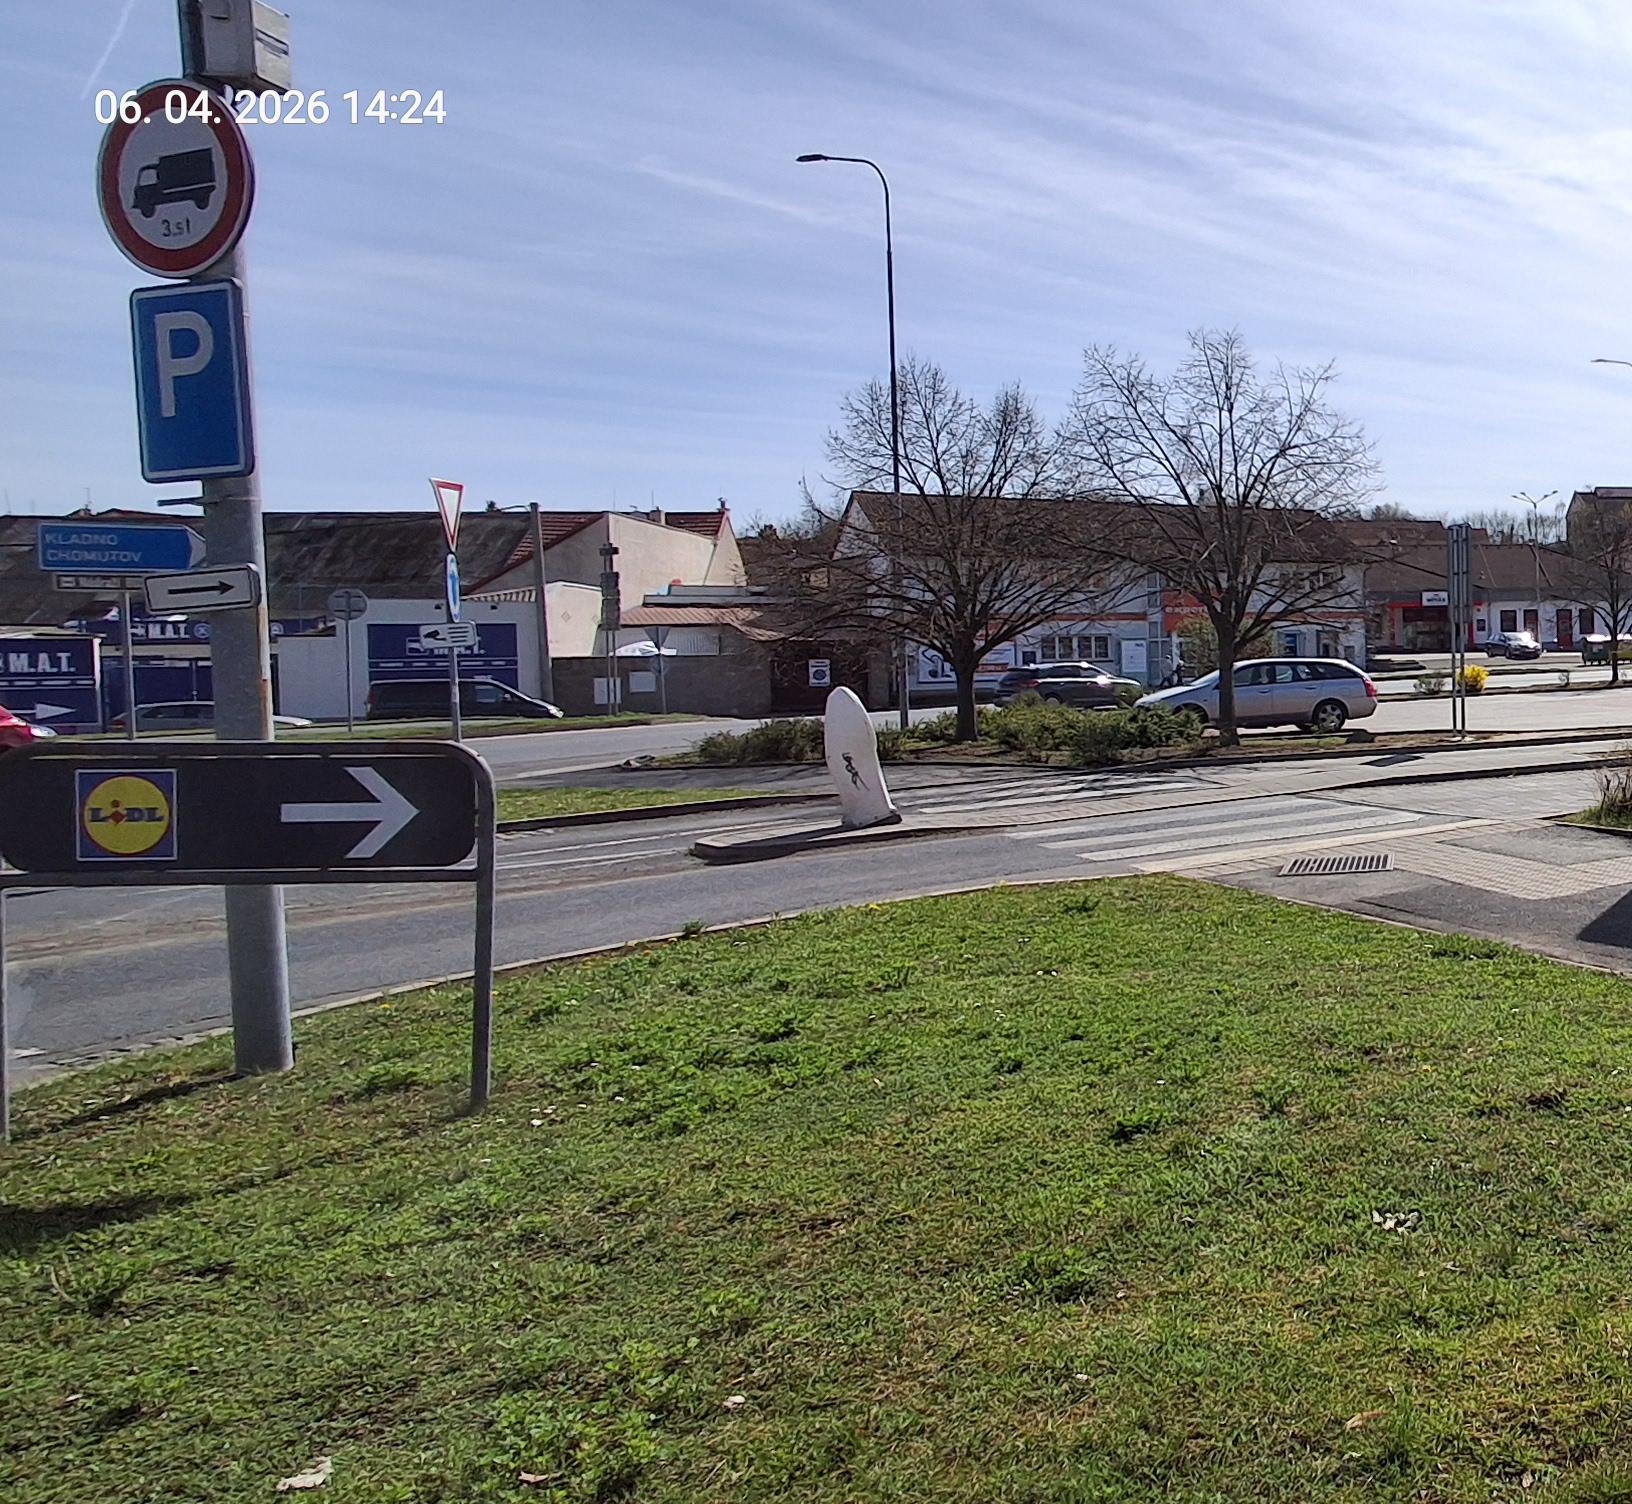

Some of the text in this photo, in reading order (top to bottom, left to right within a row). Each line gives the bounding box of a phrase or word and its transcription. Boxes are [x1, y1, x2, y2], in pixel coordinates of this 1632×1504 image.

[154, 311, 214, 418] P
[43, 532, 118, 546] KLADNO
[45, 550, 142, 563] CHOMUTOV
[9, 652, 76, 673] M.A.T.
